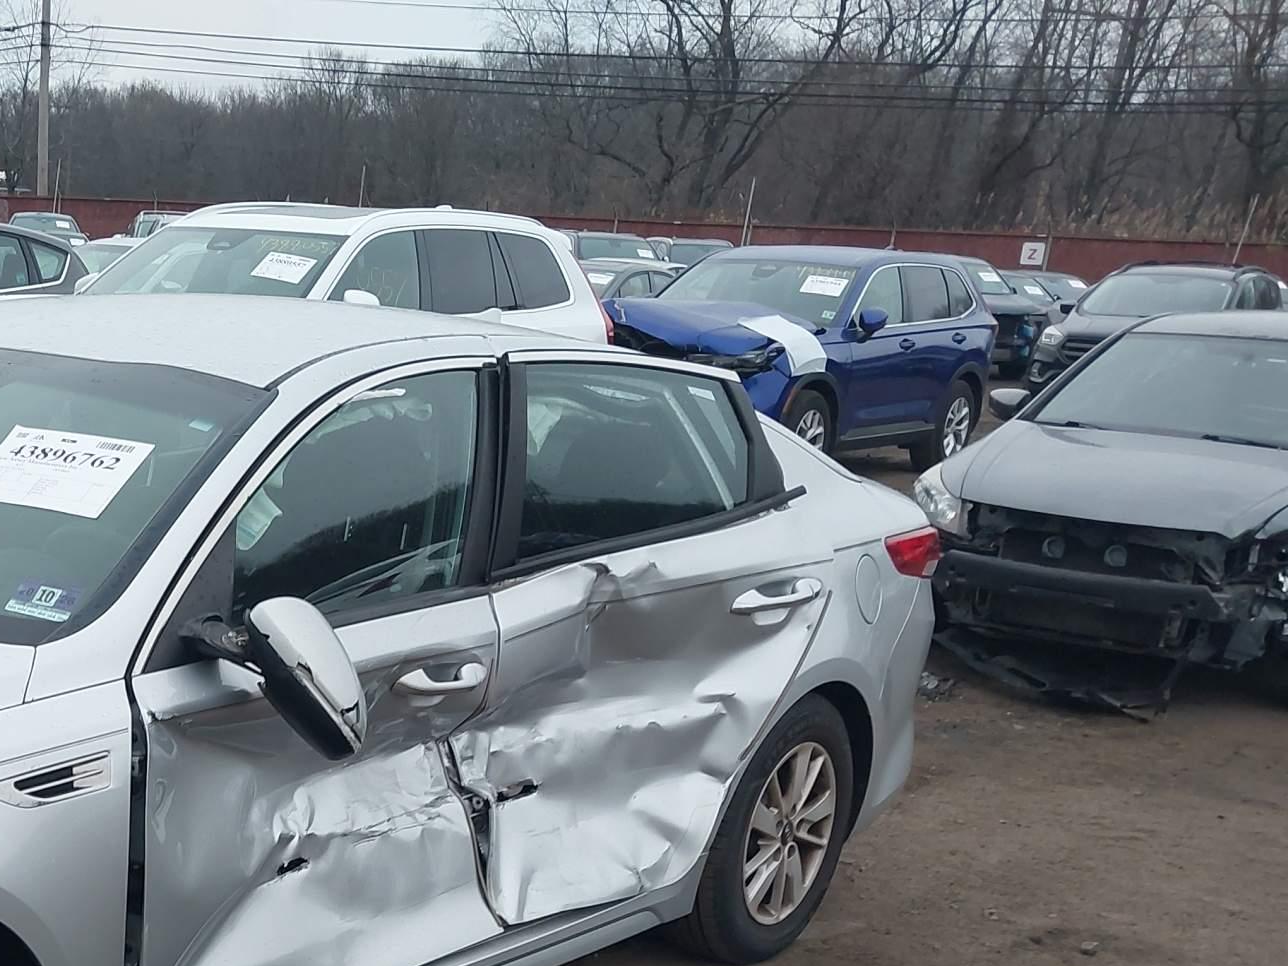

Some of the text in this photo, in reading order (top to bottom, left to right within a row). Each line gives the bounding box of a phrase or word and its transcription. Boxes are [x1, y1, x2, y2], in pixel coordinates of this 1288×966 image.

[1027, 248, 1038, 260] Z
[10, 444, 121, 471] 43896762
[36, 588, 56, 603] 10
